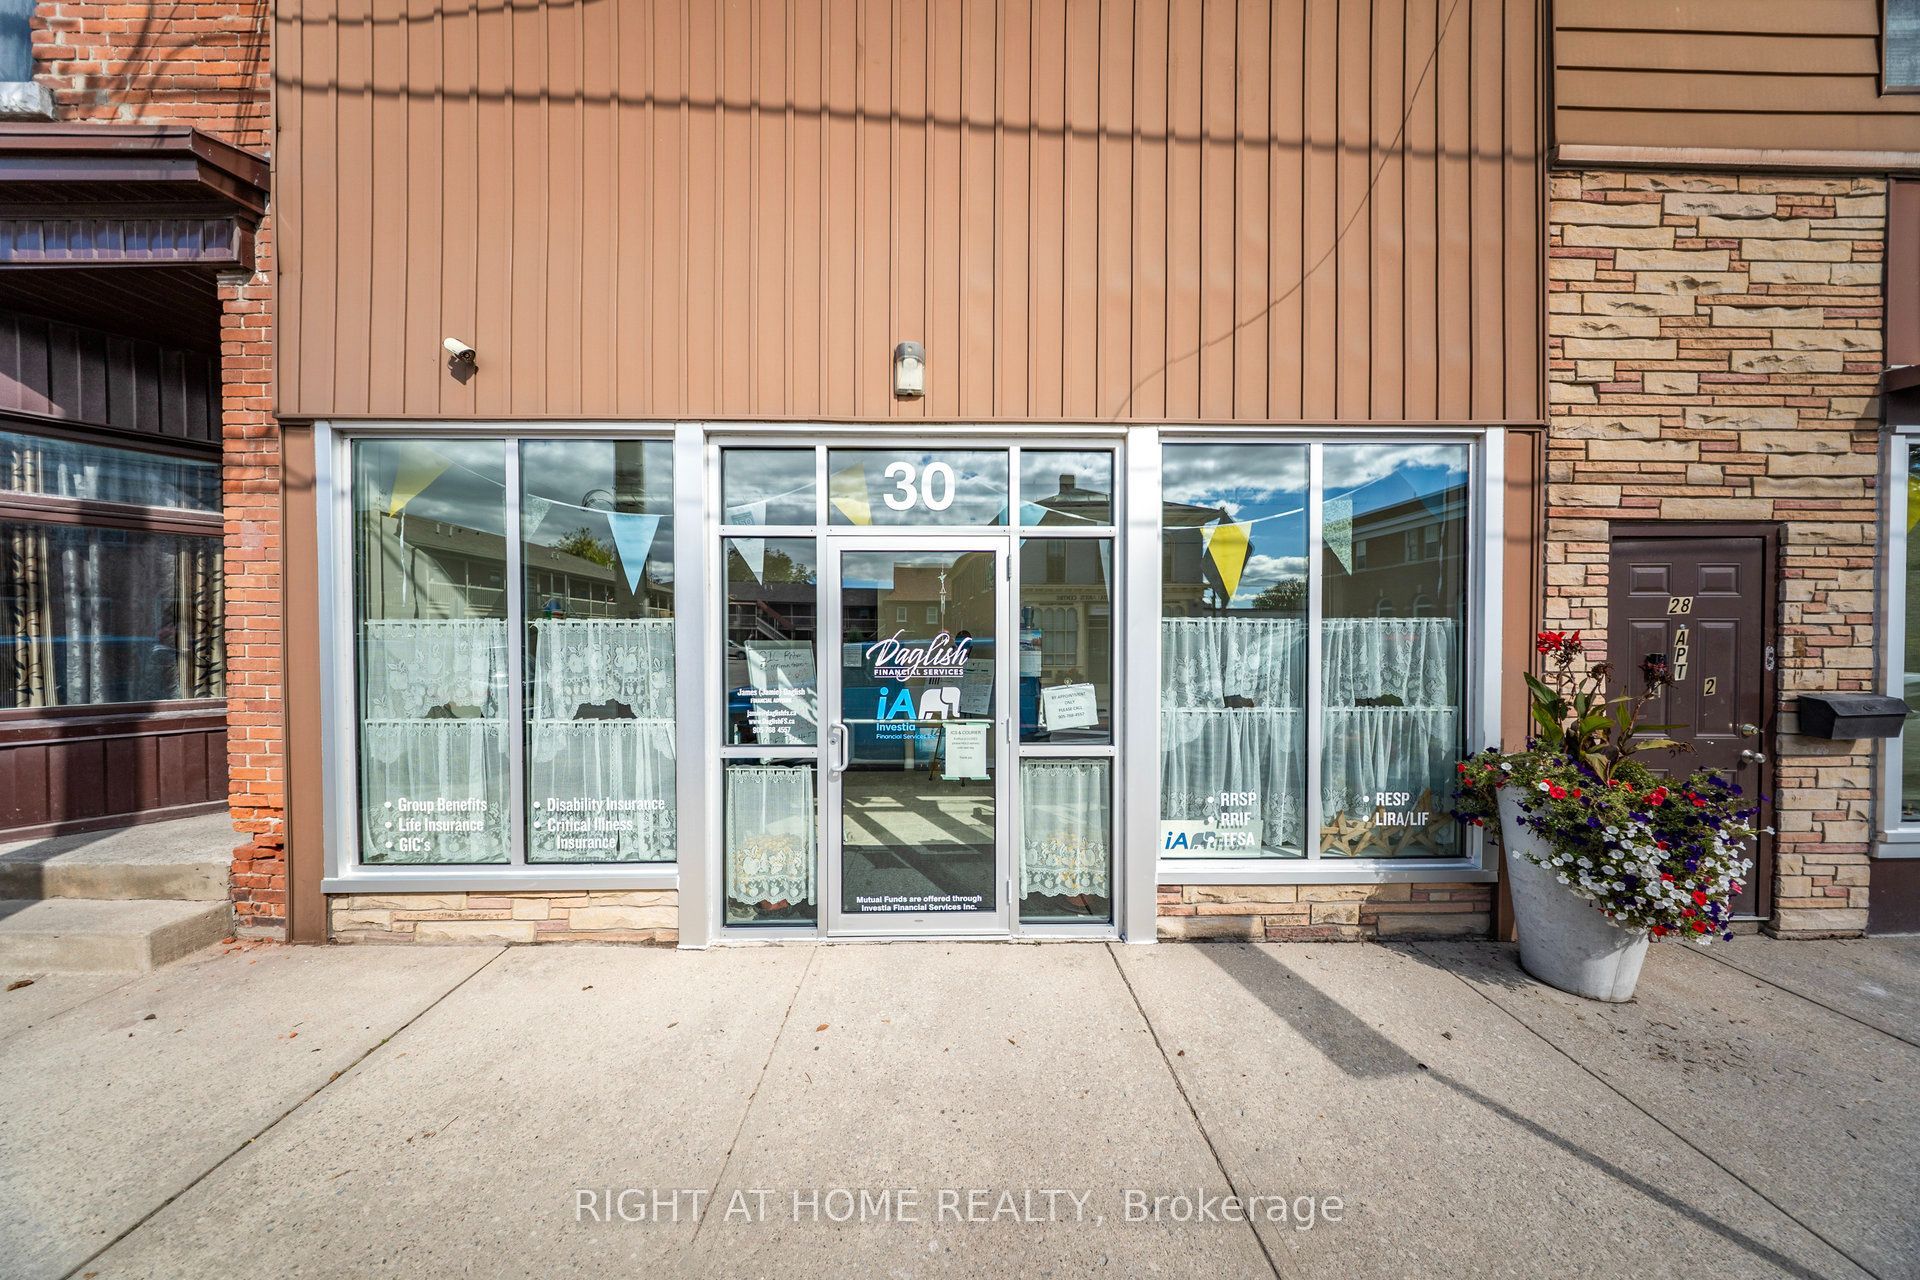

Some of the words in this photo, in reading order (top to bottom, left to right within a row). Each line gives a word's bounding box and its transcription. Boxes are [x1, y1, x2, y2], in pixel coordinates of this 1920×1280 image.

[883, 461, 956, 511] 30
[1669, 598, 1691, 613] 28
[866, 629, 972, 682] Daglish
[1675, 631, 1686, 679] APT
[874, 668, 921, 676] FINANCIAL
[923, 668, 964, 676] SERVICES
[1705, 679, 1715, 694] 2
[877, 687, 917, 720] iA
[876, 723, 916, 732] Investia
[398, 798, 434, 814] Group
[437, 797, 488, 812] Benefits
[547, 798, 603, 814] Disability
[606, 797, 665, 811] Insurance
[1220, 793, 1257, 807] RRSP
[1376, 792, 1410, 806] RESP
[398, 817, 422, 832] Life
[425, 817, 485, 832] Insurance
[547, 817, 590, 832] Critical
[594, 817, 633, 831] Illness
[1221, 812, 1251, 826] RRIF
[1375, 811, 1430, 826] LIRA/LIF
[399, 837, 431, 852] GIC's
[557, 835, 616, 850] Insurance
[1165, 831, 1189, 850] iA
[1221, 832, 1256, 846] TFSA
[952, 895, 982, 903] through
